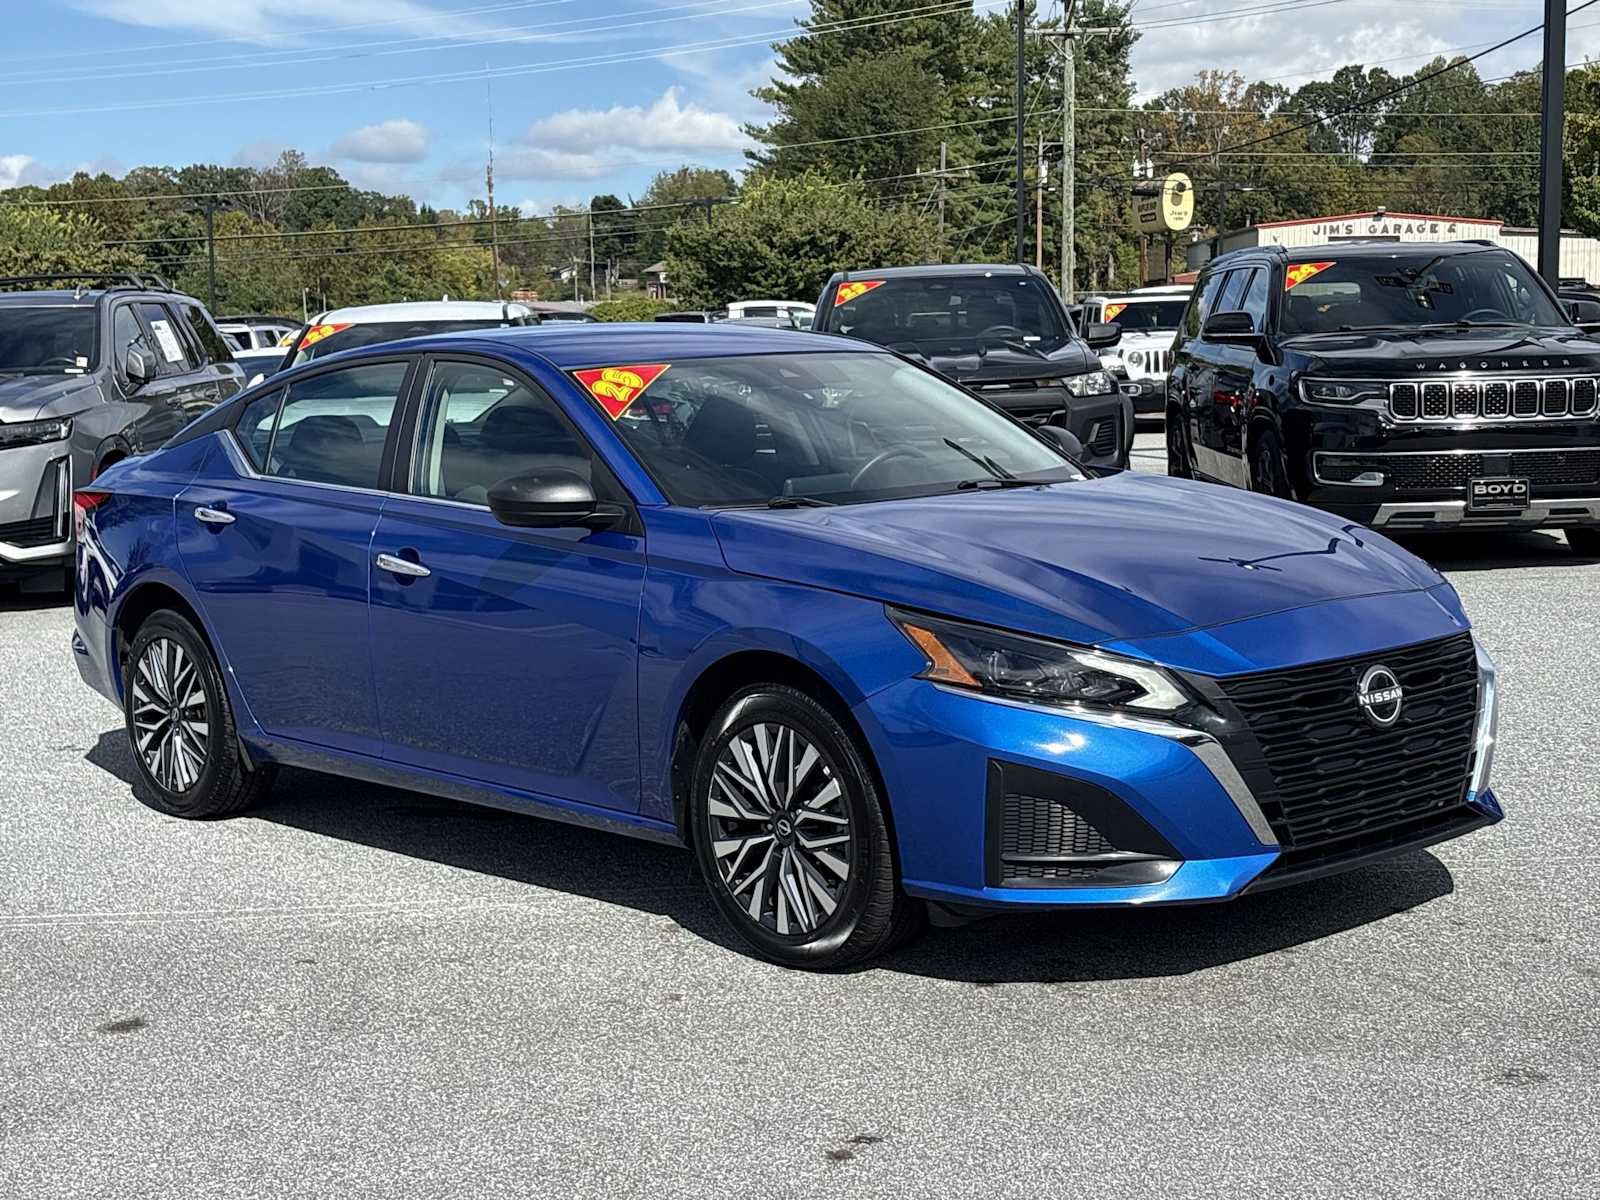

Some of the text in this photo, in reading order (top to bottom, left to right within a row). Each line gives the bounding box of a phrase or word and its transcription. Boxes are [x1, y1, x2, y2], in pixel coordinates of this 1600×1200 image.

[1312, 222, 1353, 235] JIM'S
[1368, 222, 1439, 234] GARAGE
[1416, 359, 1570, 369] WAGONEER
[591, 368, 644, 402] 25
[1474, 484, 1527, 494] BOYD
[1359, 686, 1403, 705] NISSAN
